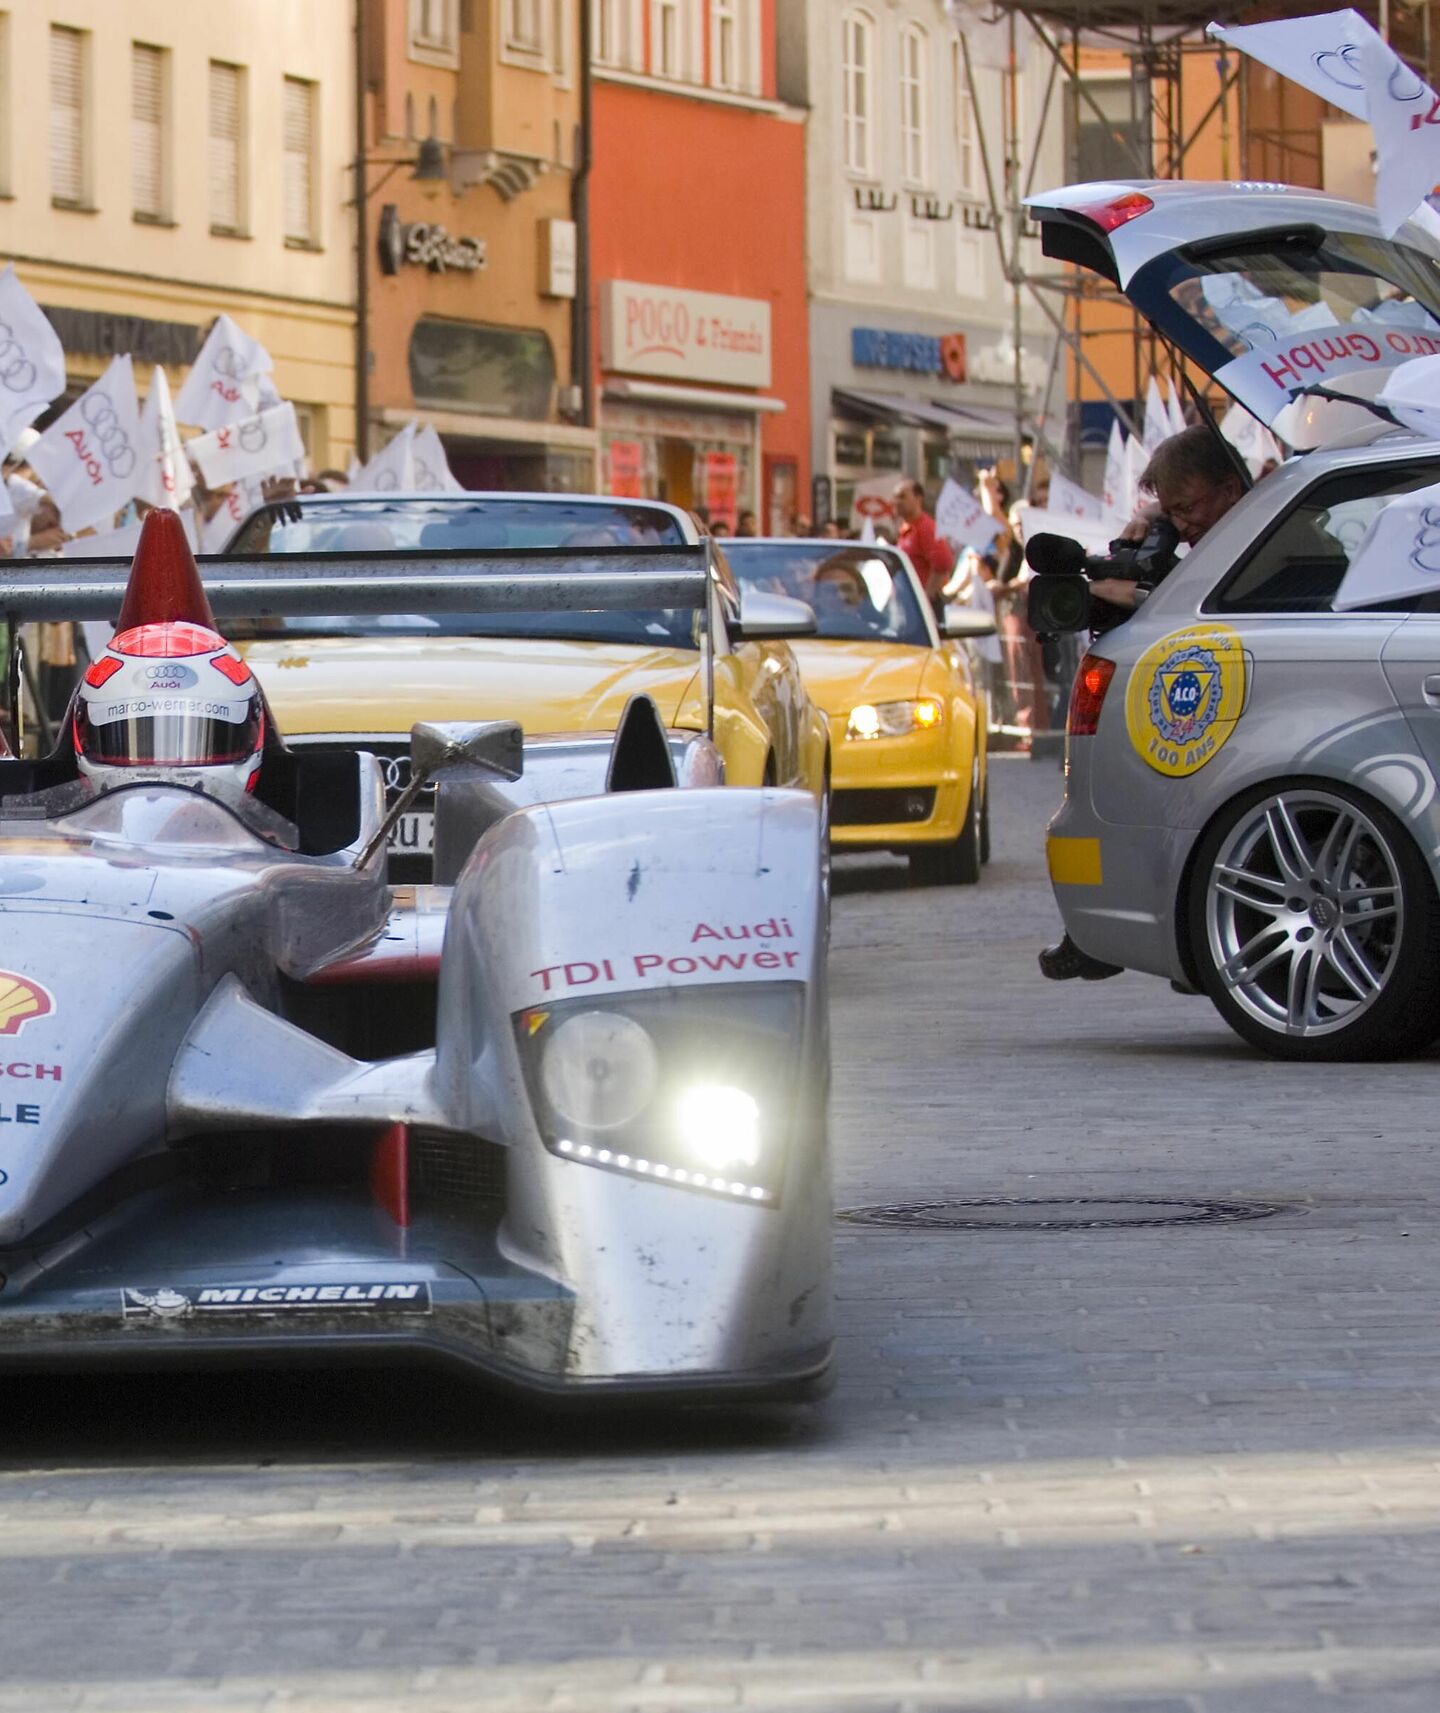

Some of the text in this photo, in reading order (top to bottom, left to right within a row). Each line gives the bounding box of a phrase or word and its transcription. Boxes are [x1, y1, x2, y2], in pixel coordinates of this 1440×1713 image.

[1260, 333, 1381, 391] GmbH
[150, 680, 181, 689] Audi
[108, 699, 231, 717] marco-werner.com
[690, 918, 794, 943] Audi
[530, 951, 800, 991] TDI Power
[198, 1284, 419, 1303] MICHELIN
